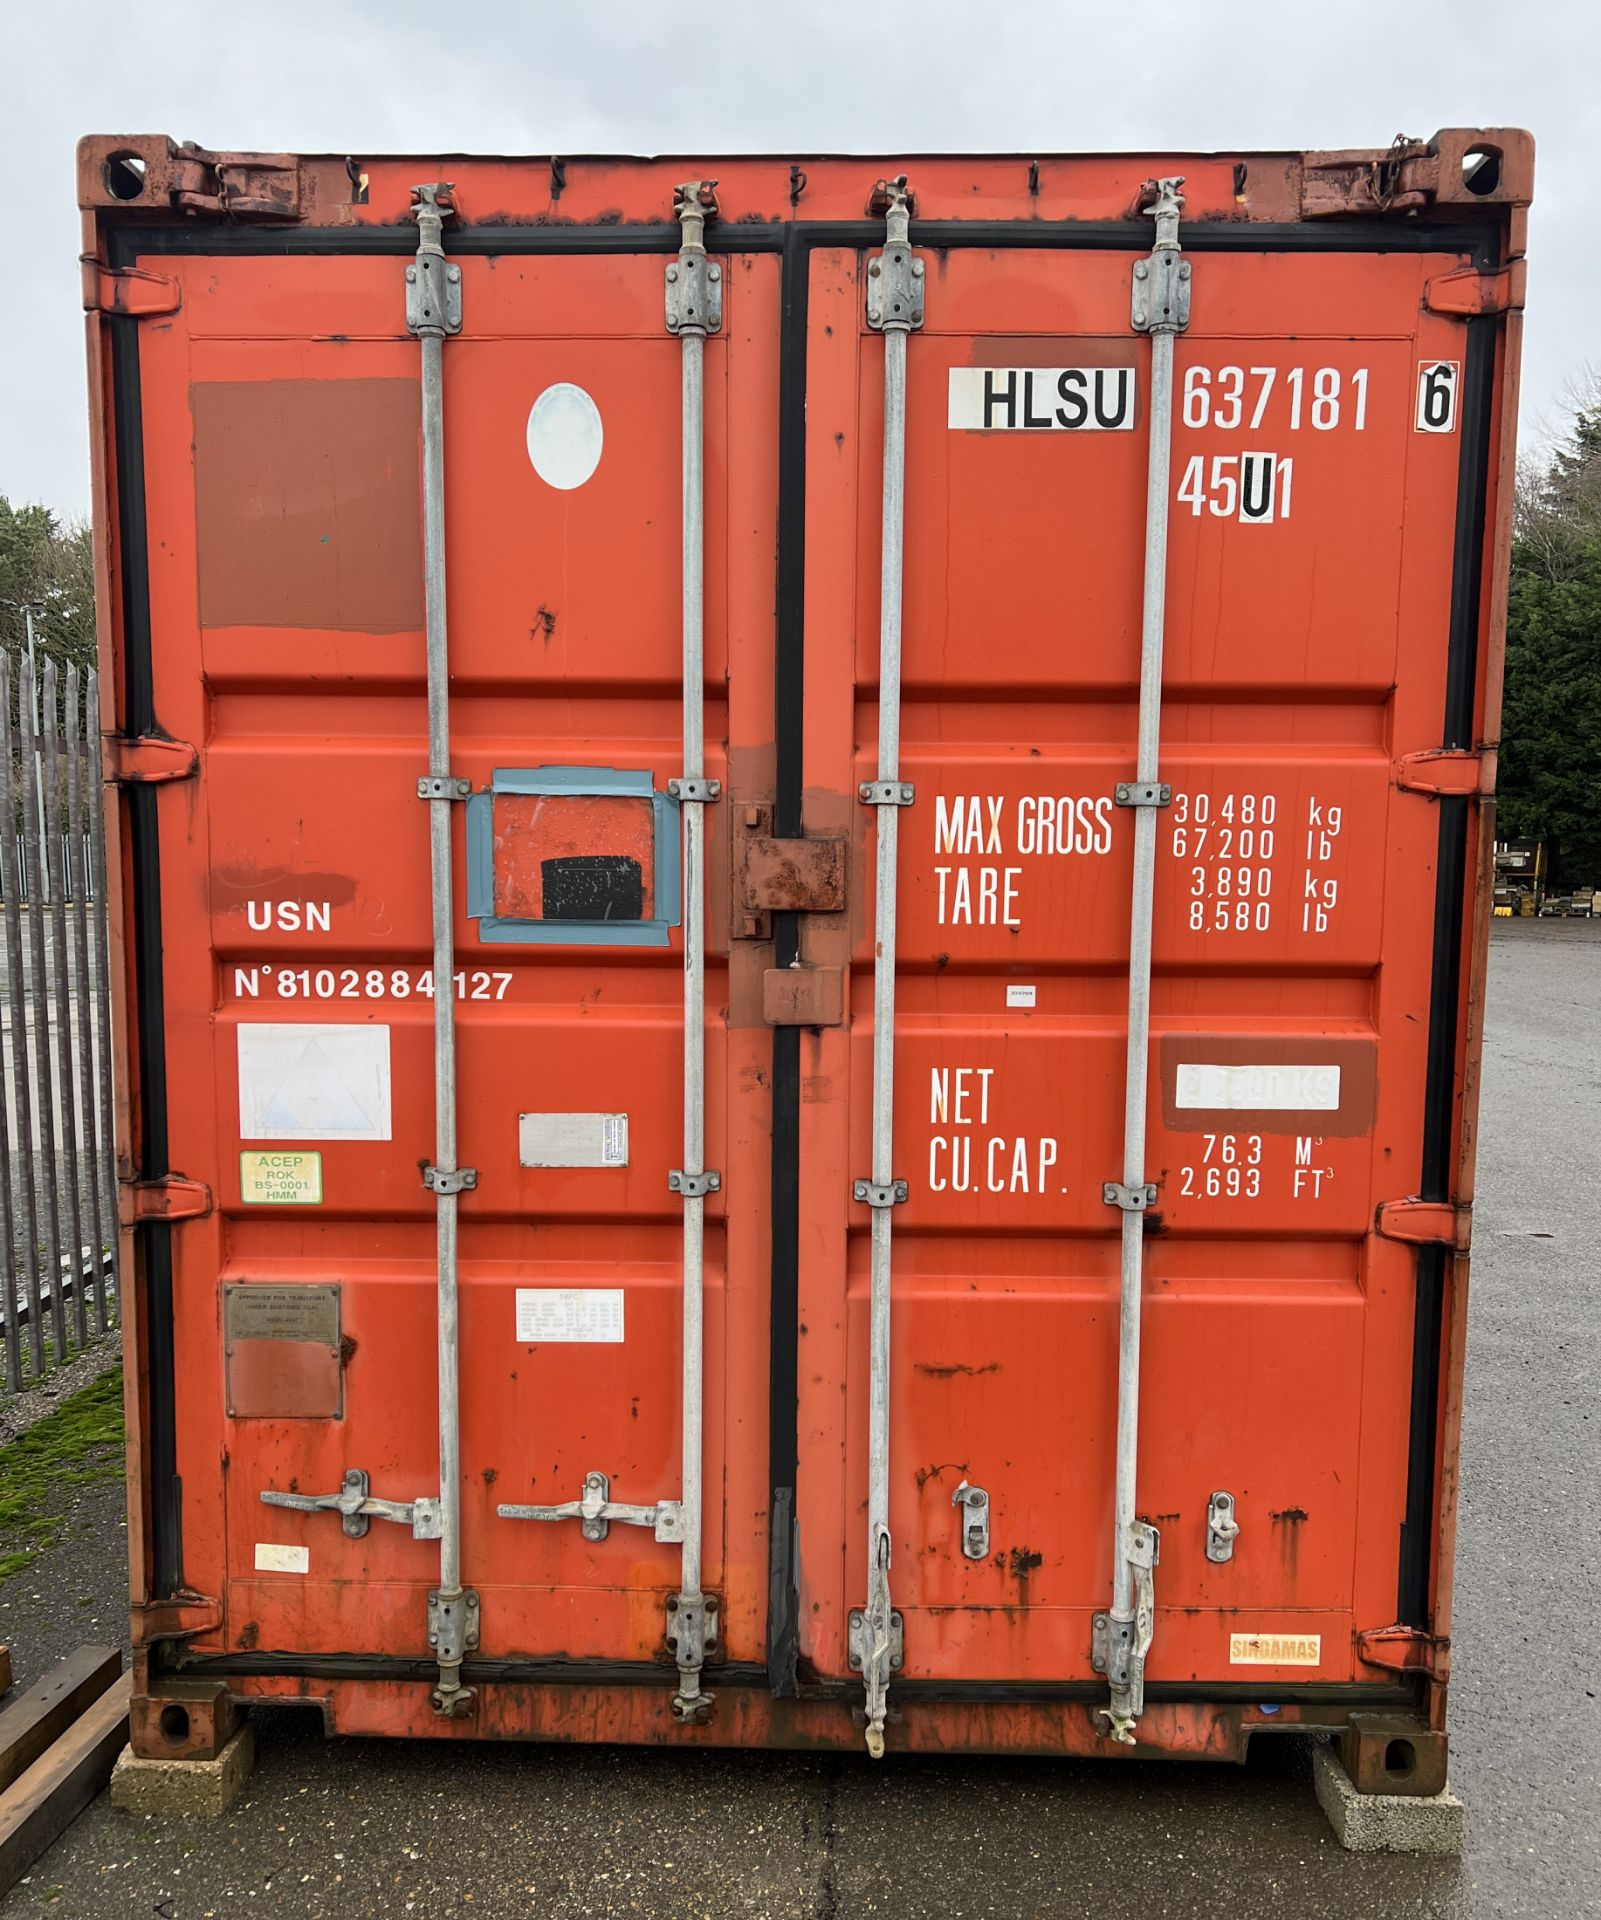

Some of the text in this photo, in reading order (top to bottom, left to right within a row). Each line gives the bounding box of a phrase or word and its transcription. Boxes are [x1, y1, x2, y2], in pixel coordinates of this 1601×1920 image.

[985, 366, 1452, 431] HLSU 637181 6
[1177, 454, 1293, 519] 45U1
[935, 796, 1113, 855] MAX GROSS
[1174, 794, 1342, 836] 30,480 kg
[1173, 828, 1332, 860] 67,200 lb
[935, 867, 1022, 925] TARE
[1191, 867, 1338, 909] 3,890 kg
[247, 901, 330, 931] USN
[1189, 901, 1328, 932] 8,580 lb
[931, 1068, 994, 1124] NET
[258, 1156, 303, 1167] ACEP
[1202, 1135, 1262, 1166] 76.3
[255, 1181, 308, 1190] BS-0001
[266, 1171, 295, 1180] ROK
[1181, 1167, 1261, 1199] 2,693
[266, 1191, 297, 1200] HMM
